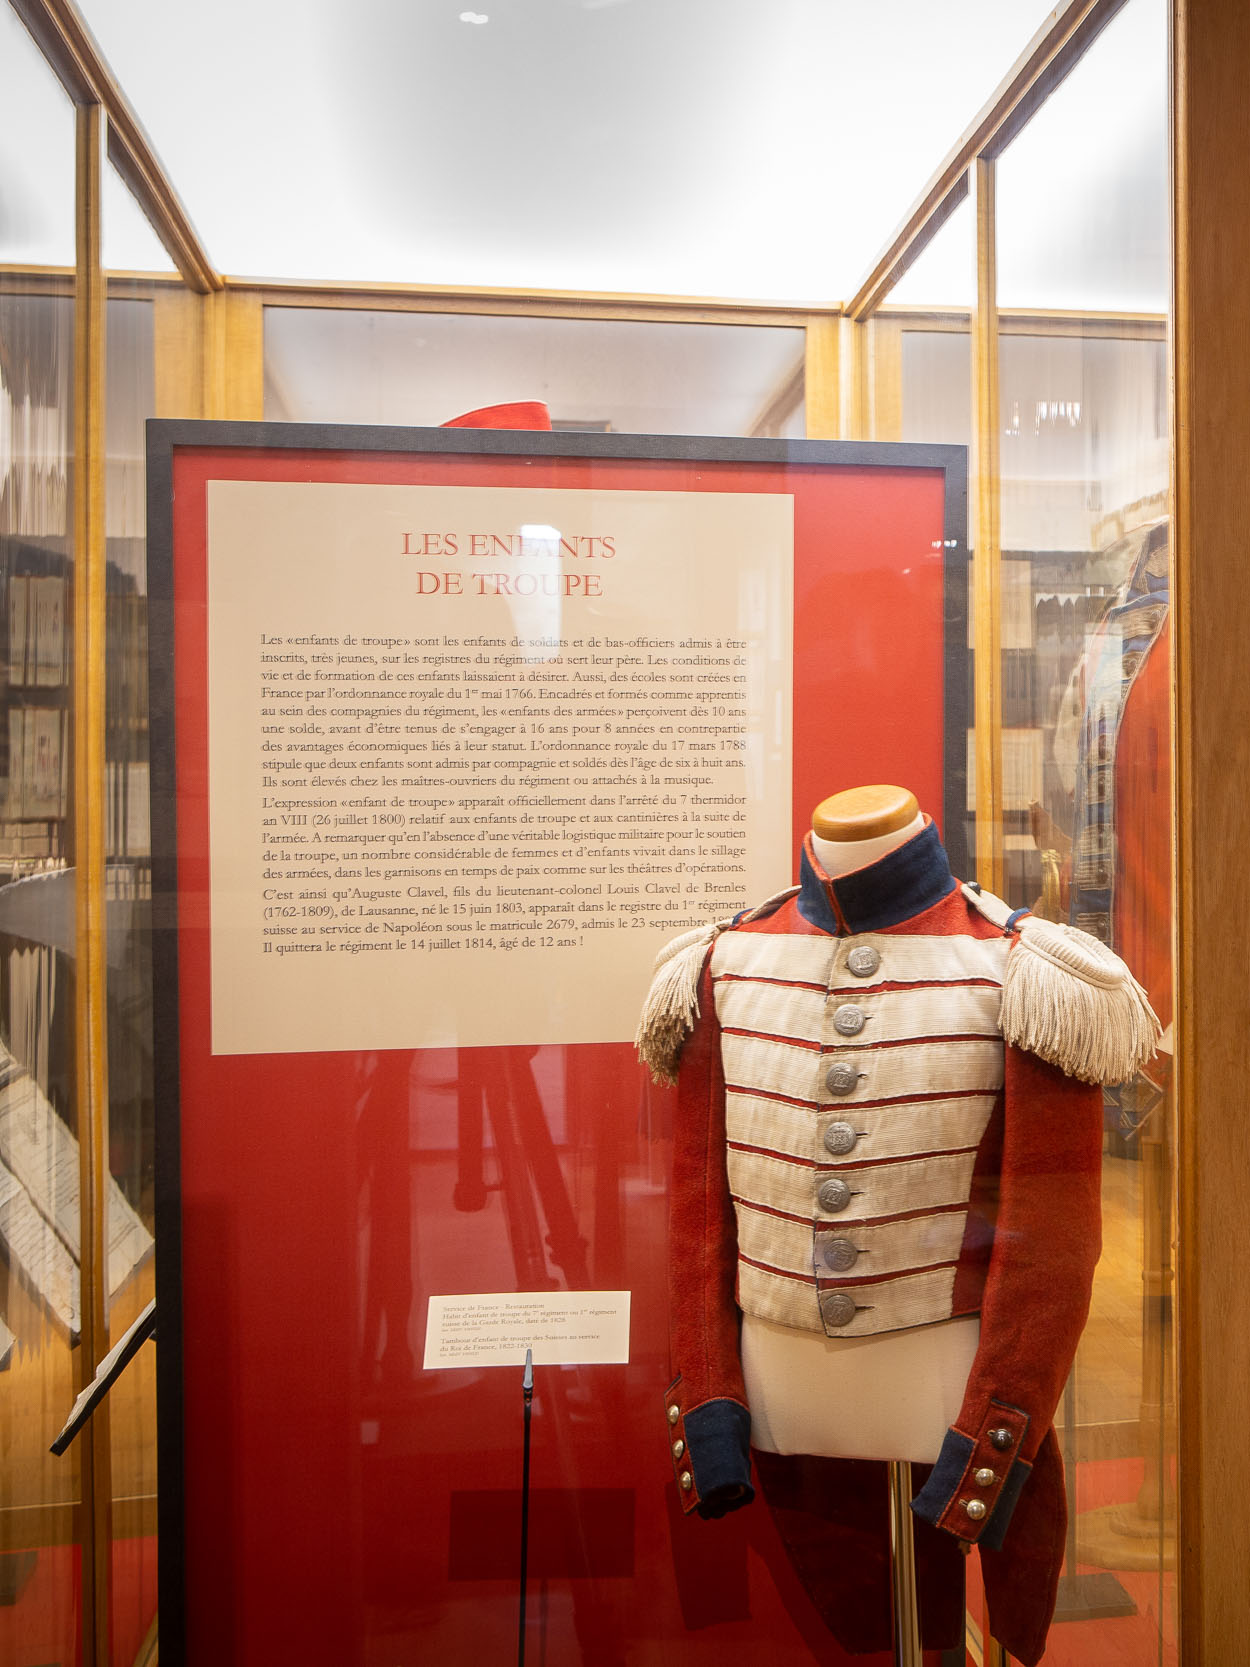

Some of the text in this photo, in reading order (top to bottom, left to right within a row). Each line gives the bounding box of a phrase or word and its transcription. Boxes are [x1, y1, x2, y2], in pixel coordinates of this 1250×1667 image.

[401, 533, 459, 556] LES
[416, 572, 603, 597] DE TROUPE
[262, 670, 278, 681] vie
[282, 671, 292, 681] et
[296, 669, 311, 681] de
[314, 669, 375, 681] formation
[378, 669, 393, 681] de
[396, 673, 414, 682] ces
[417, 670, 460, 682] enfants
[463, 670, 515, 682] laissaient
[528, 670, 568, 682] désirer.
[572, 670, 606, 685] Aussi,
[609, 670, 628, 682] des
[631, 670, 666, 682] écoles
[669, 672, 693, 683] sont
[697, 671, 730, 683] créées
[733, 674, 746, 683] en
[262, 726, 284, 734] une
[289, 722, 325, 737] solde,
[329, 724, 360, 734] avant
[405, 724, 437, 734] tenus
[442, 722, 456, 734] de
[531, 722, 544, 734] 16
[548, 726, 568, 734] ans
[572, 726, 600, 737] pour
[615, 722, 655, 734] années
[659, 725, 673, 734] en
[677, 723, 746, 737] contrepartie
[262, 739, 282, 751] des
[286, 741, 344, 754] avantages
[348, 739, 427, 754] économiques
[431, 739, 450, 751] liés
[465, 739, 488, 751] leur
[492, 741, 526, 751] statut.
[614, 739, 648, 754] royale
[652, 739, 667, 751] du
[672, 739, 684, 751] 17
[688, 742, 716, 751] mars
[720, 738, 746, 751] 1788
[262, 774, 277, 787] Ils
[281, 776, 306, 786] sont
[311, 774, 346, 786] élevés
[350, 774, 378, 786] chez
[382, 774, 397, 786] les
[401, 774, 496, 786] maîtres-ouvriers
[500, 774, 515, 786] du
[519, 774, 569, 789] régiment
[574, 777, 588, 786] ou
[592, 773, 637, 786] attachés
[650, 773, 660, 785] la
[664, 774, 713, 788] musique.
[324, 834, 386, 846] remarquer
[511, 829, 560, 841] véritable
[562, 828, 616, 844] logistique
[618, 828, 664, 840] militaire
[666, 831, 693, 843] pour
[695, 827, 704, 839] le
[706, 828, 745, 839] soutien
[262, 867, 282, 879] des
[286, 866, 331, 882] armées,
[334, 866, 362, 878] dans
[364, 865, 381, 878] les
[384, 866, 441, 880] garnisons
[444, 868, 458, 877] en
[461, 866, 497, 880] temps
[500, 864, 513, 876] de
[516, 865, 540, 879] paix
[543, 867, 586, 875] comme
[589, 866, 606, 875] sur
[609, 863, 624, 875] les
[627, 862, 672, 874] théâtres
[298, 888, 326, 899] ainsi
[406, 885, 447, 901] Clavel,
[453, 885, 470, 897] fils
[476, 884, 491, 897] du
[496, 883, 601, 896] lieutenant-colonel
[607, 882, 639, 895] Louis
[644, 882, 680, 894] Clavel
[686, 882, 698, 894] de
[704, 881, 746, 893] Brenles
[263, 941, 272, 953] Il
[275, 941, 322, 956] quittera
[325, 940, 336, 952] le
[340, 939, 392, 955] régiment
[396, 939, 406, 951] le
[411, 938, 424, 950] 14
[428, 937, 460, 953] juillet
[465, 937, 496, 952] 1814,
[499, 936, 518, 952] âgé
[521, 936, 535, 948] de
[540, 936, 553, 948] 12
[557, 939, 576, 948] ans
